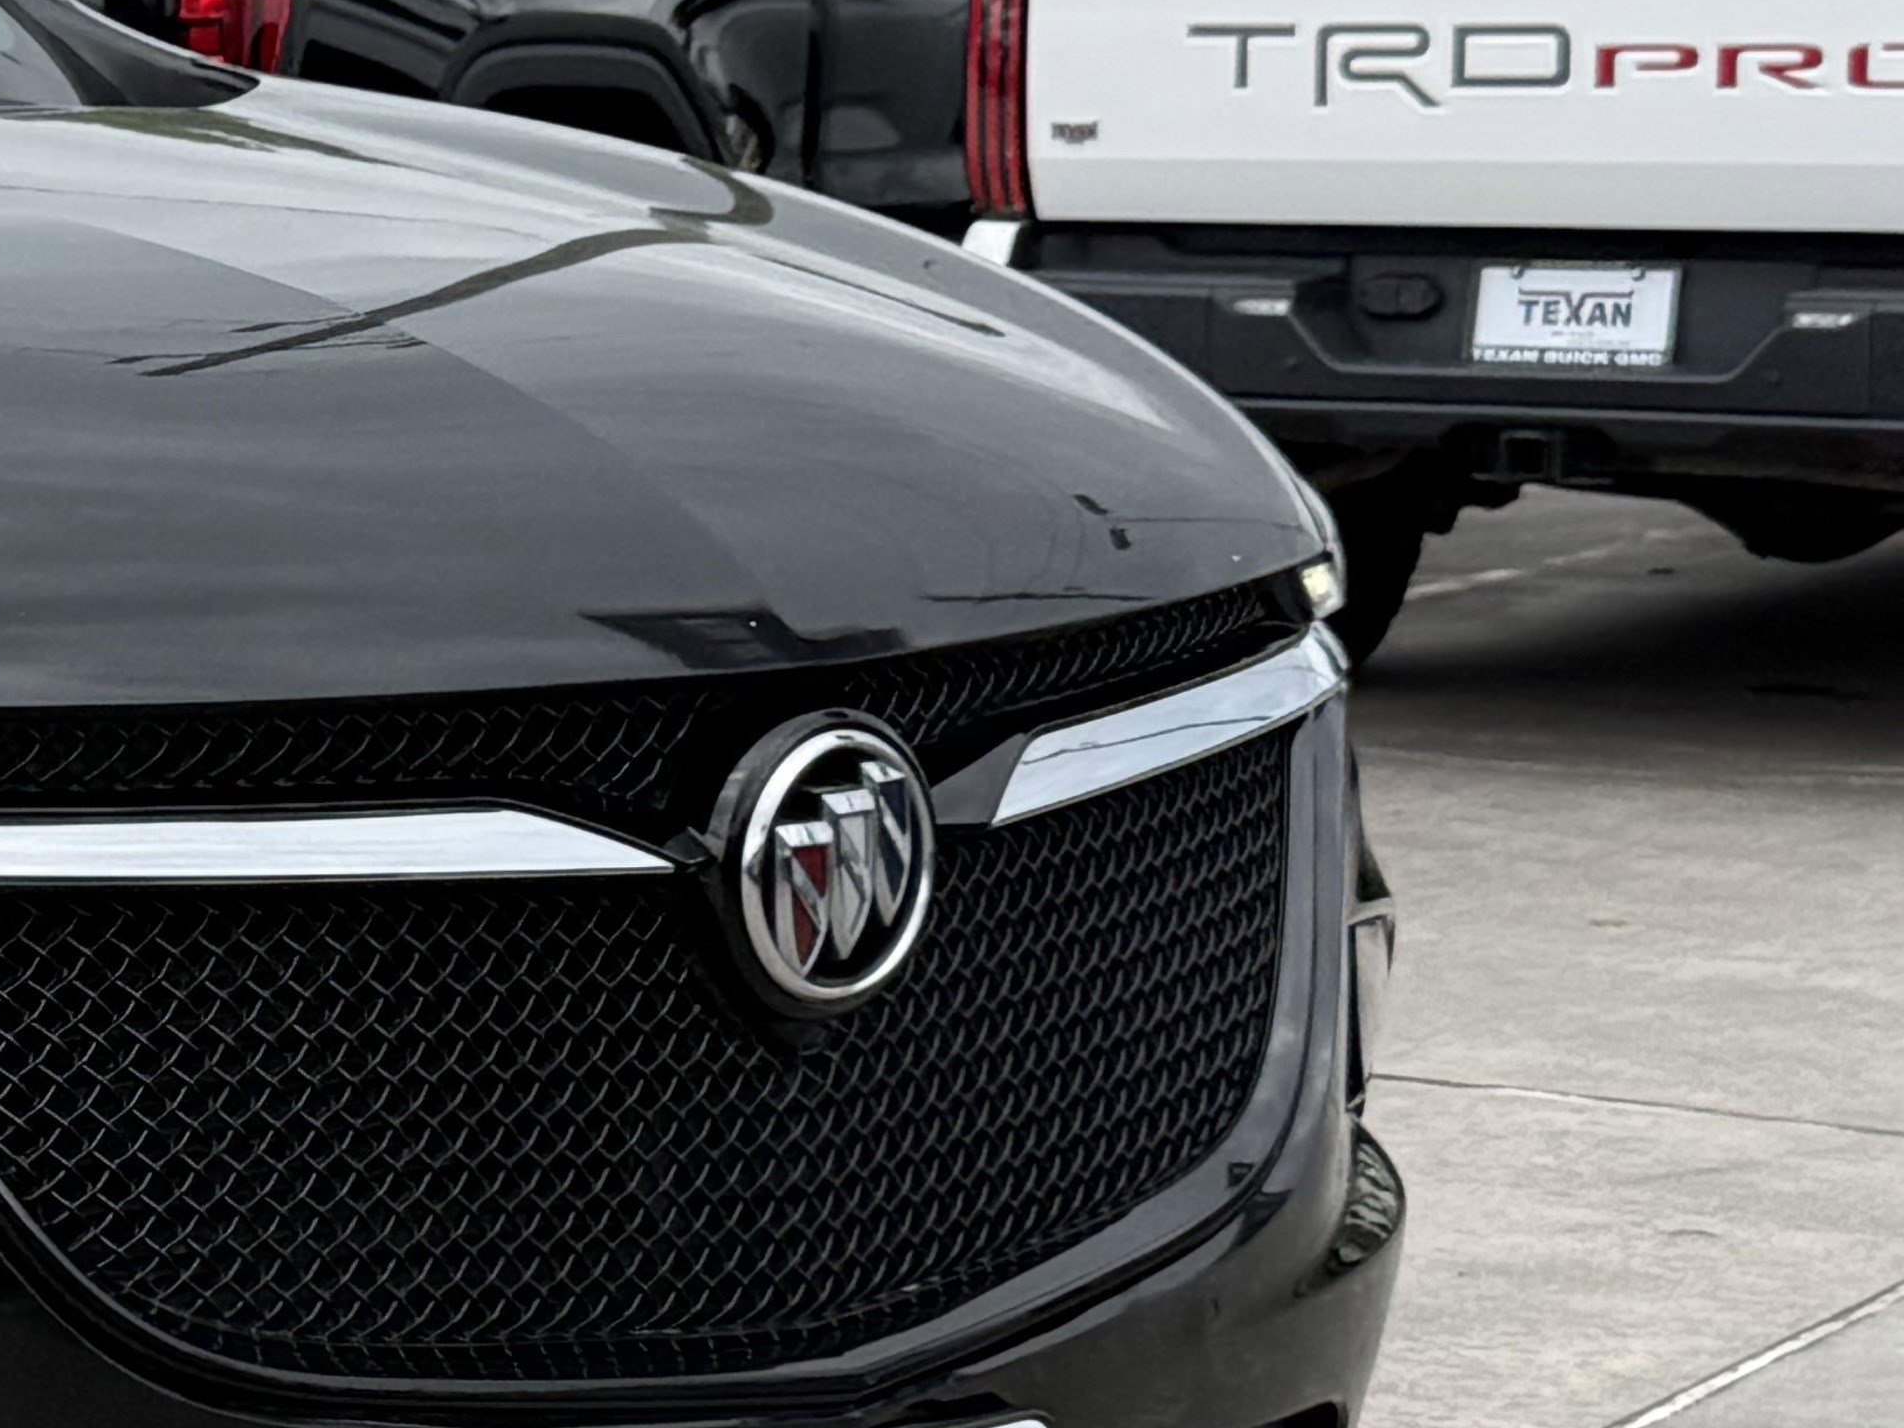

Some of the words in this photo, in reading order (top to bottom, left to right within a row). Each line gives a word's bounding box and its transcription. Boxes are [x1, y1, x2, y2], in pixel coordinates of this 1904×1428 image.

[1187, 23, 1572, 107] TRD
[1518, 287, 1634, 327] TEXAN
[1472, 347, 1539, 363] TEXAN
[1543, 349, 1609, 365] BUICK
[1613, 350, 1663, 366] GMC
